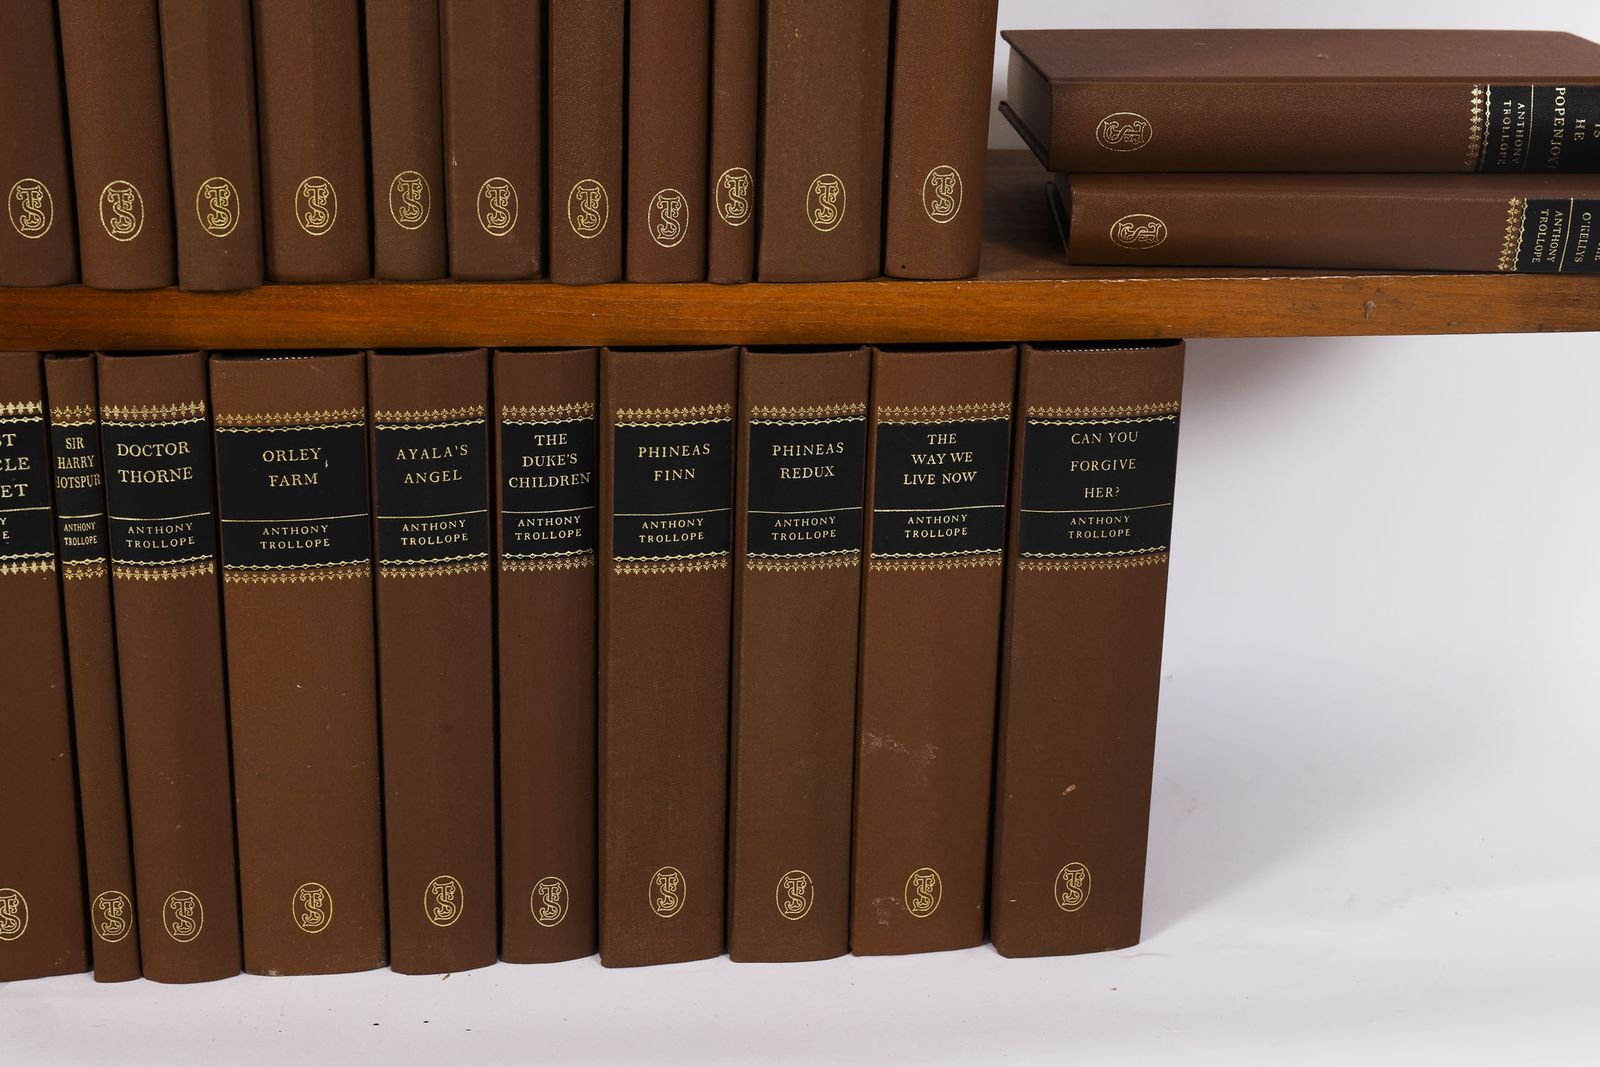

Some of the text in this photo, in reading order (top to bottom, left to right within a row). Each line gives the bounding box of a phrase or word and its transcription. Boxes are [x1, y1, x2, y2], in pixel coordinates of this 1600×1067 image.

[1497, 99, 1512, 166] TROLLOPE
[1512, 103, 1525, 164] ANTHONY
[1574, 118, 1585, 141] HE
[1532, 208, 1549, 263] TROLLOPE
[1547, 210, 1563, 262] ANTHONY
[1573, 211, 1592, 263] O'KELLYS
[65, 436, 86, 450] SIR
[533, 432, 568, 447] THE
[926, 432, 958, 445] THE
[1070, 430, 1139, 445] CAN YOU
[116, 441, 191, 458] DOCTOR
[262, 447, 322, 463] ORLEY
[396, 444, 468, 461] AYALA'S
[638, 442, 711, 459] PHINEAS
[771, 441, 845, 457] PHINEAS
[56, 454, 95, 470] HARRY
[521, 452, 579, 468] DUKE'S
[910, 450, 974, 466] WAY WE
[1070, 457, 1137, 473] FORGIVE
[117, 466, 194, 484] THORNE
[268, 472, 319, 488] FARM
[403, 469, 464, 484] ANGEL
[508, 471, 592, 489] CHILDREN
[653, 468, 696, 483] FINN
[779, 465, 836, 480] REDUX
[903, 470, 978, 486] LIVE NOW
[1083, 486, 1121, 500] HER?
[402, 519, 467, 532] ANTHONY
[517, 514, 582, 528] ANTHONY
[641, 518, 705, 530] ANTHONY
[774, 515, 837, 528] ANTHONY
[907, 513, 968, 525] ANTHONY
[1069, 514, 1131, 527] ANTHONY
[63, 521, 96, 533] ANTHONY
[127, 522, 193, 535] ANTHONY
[262, 524, 329, 536] ANTHONY
[514, 528, 582, 541] TROLLOPE
[903, 526, 968, 539] TROLLOPE
[1068, 528, 1131, 540] TROLLOPE
[63, 534, 98, 547] TROLLOPE
[125, 535, 195, 549] TROLLOPE
[400, 532, 469, 546] TROLLOPE
[638, 531, 705, 544] TROLLOPE
[771, 529, 837, 541] TROLLOPE
[259, 538, 331, 550] TROLLOPE
